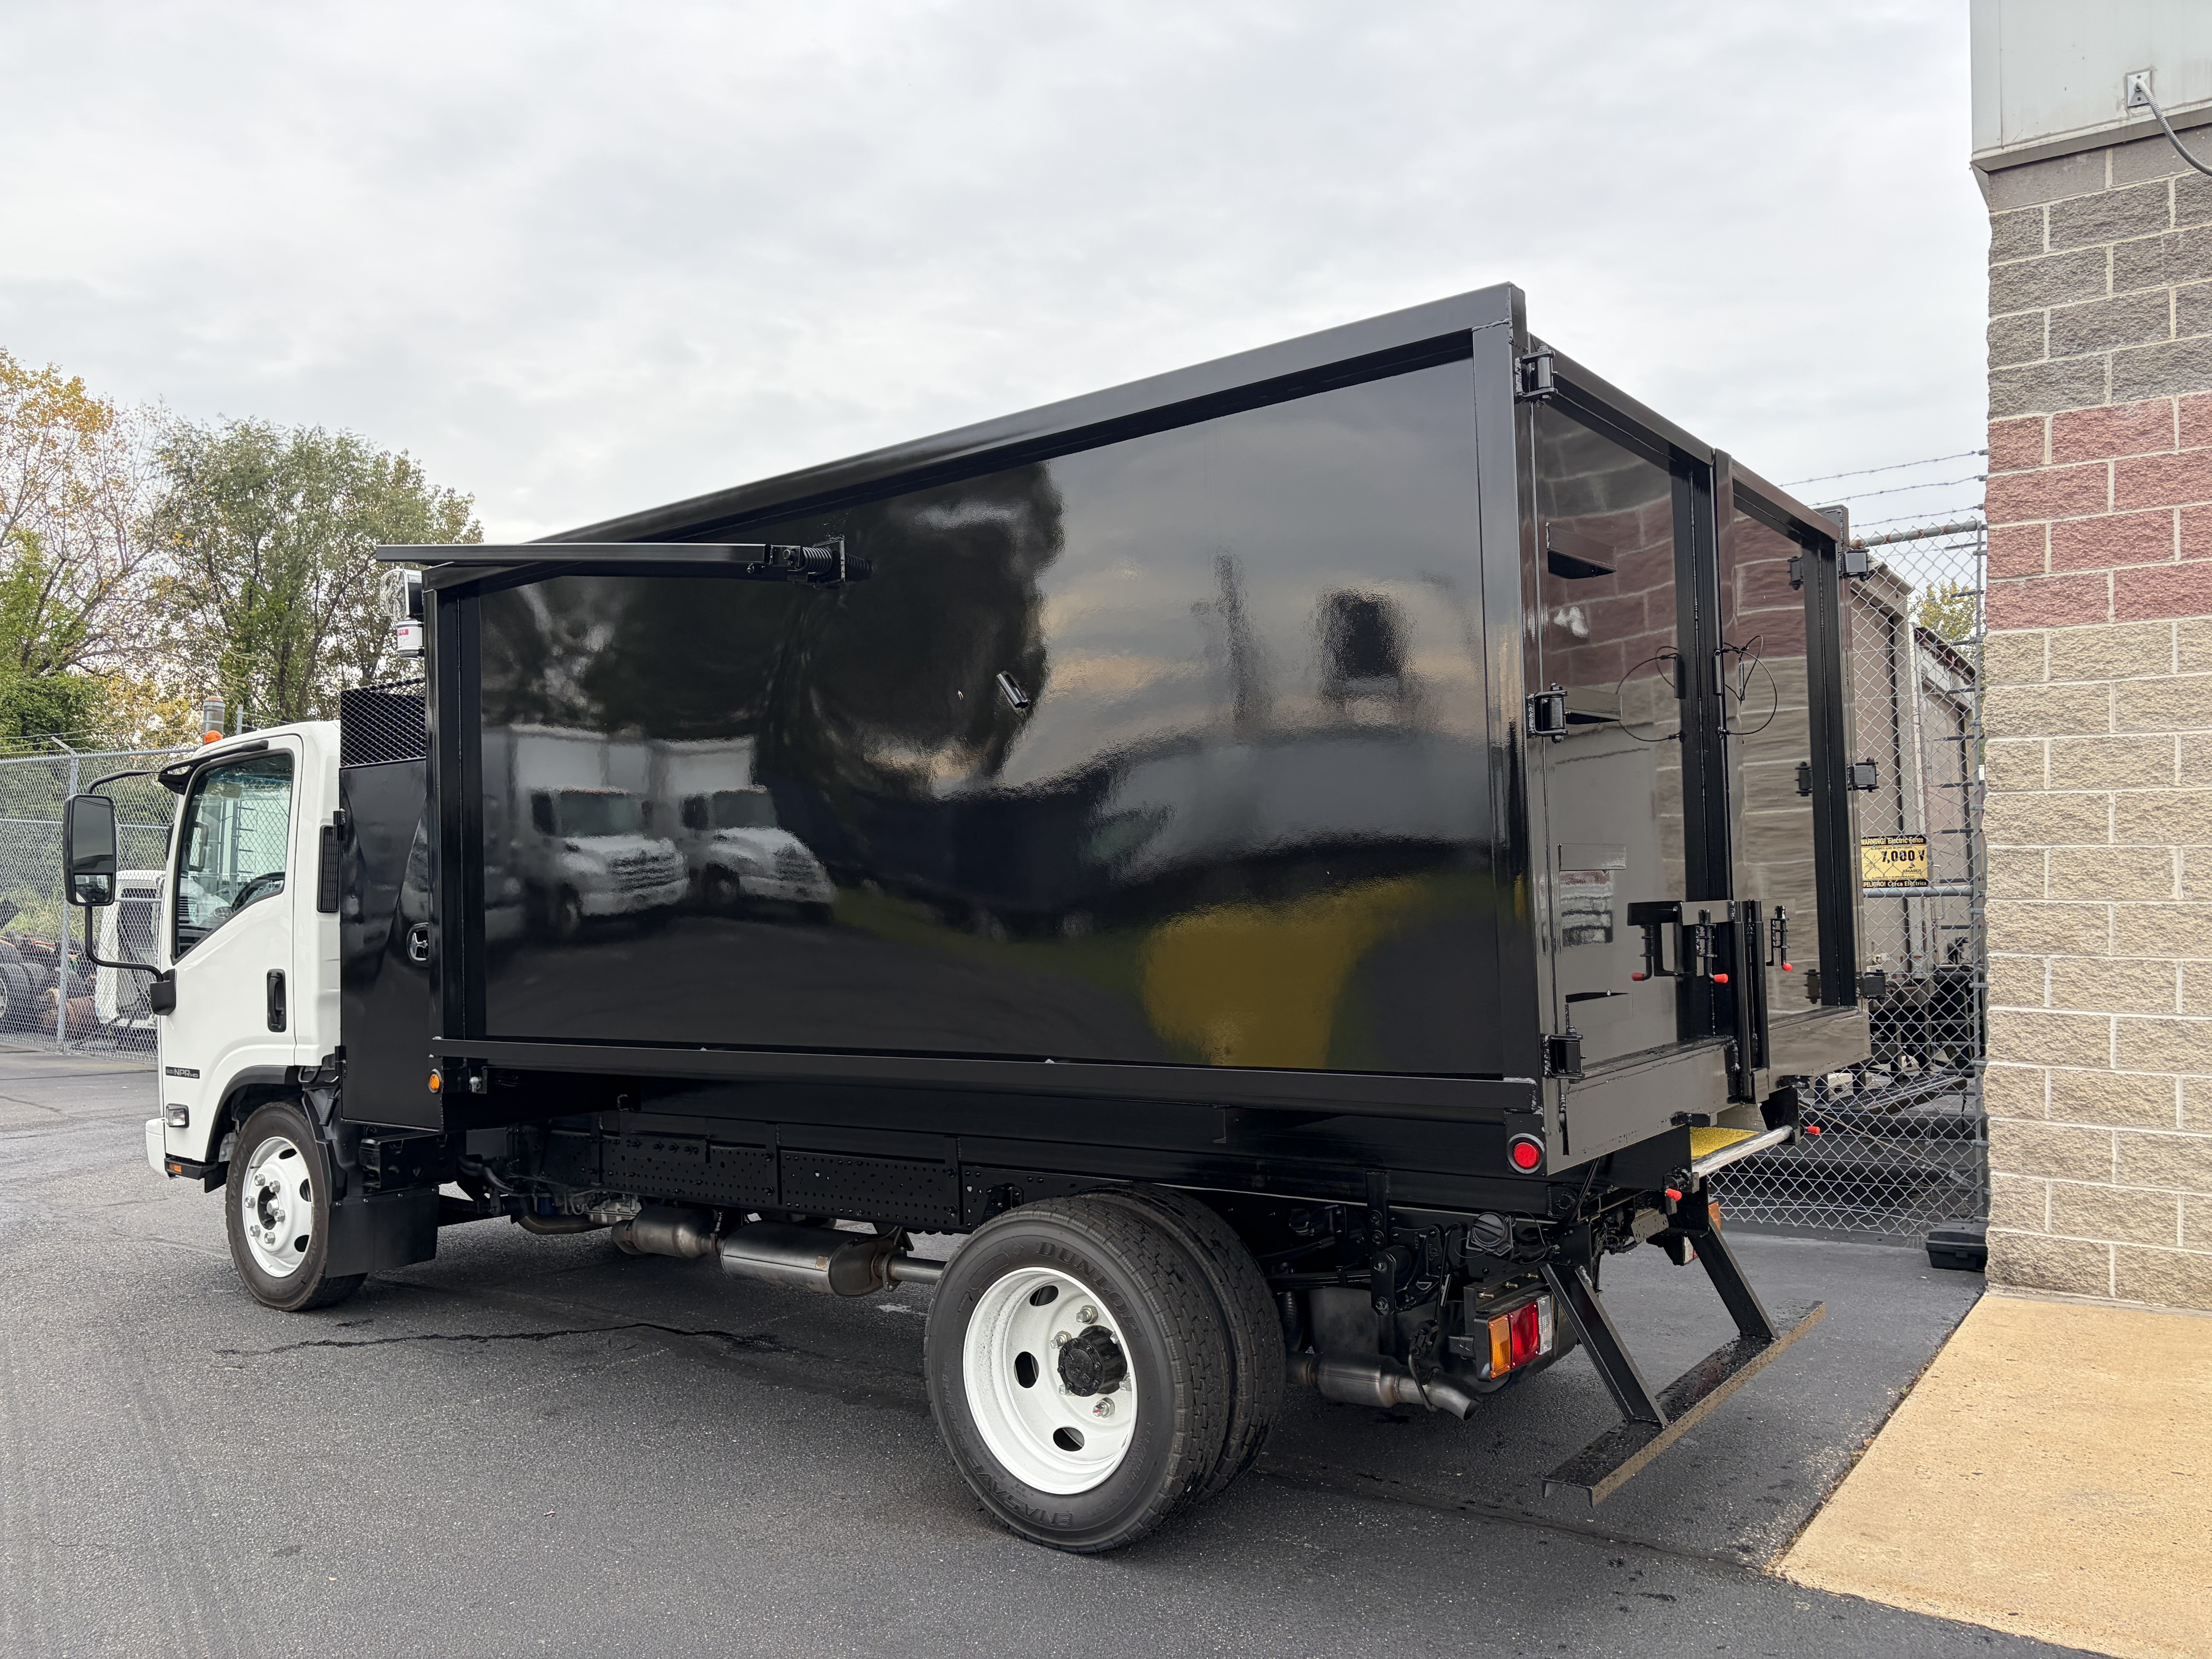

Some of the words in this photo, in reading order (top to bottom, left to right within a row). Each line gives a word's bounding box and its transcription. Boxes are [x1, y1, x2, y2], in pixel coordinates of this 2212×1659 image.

[1881, 850, 1915, 864] 7,000
[174, 1068, 190, 1077] NPR
[1036, 1241, 1142, 1338] DUNLOP
[967, 1455, 1073, 1527] ENASAVE
